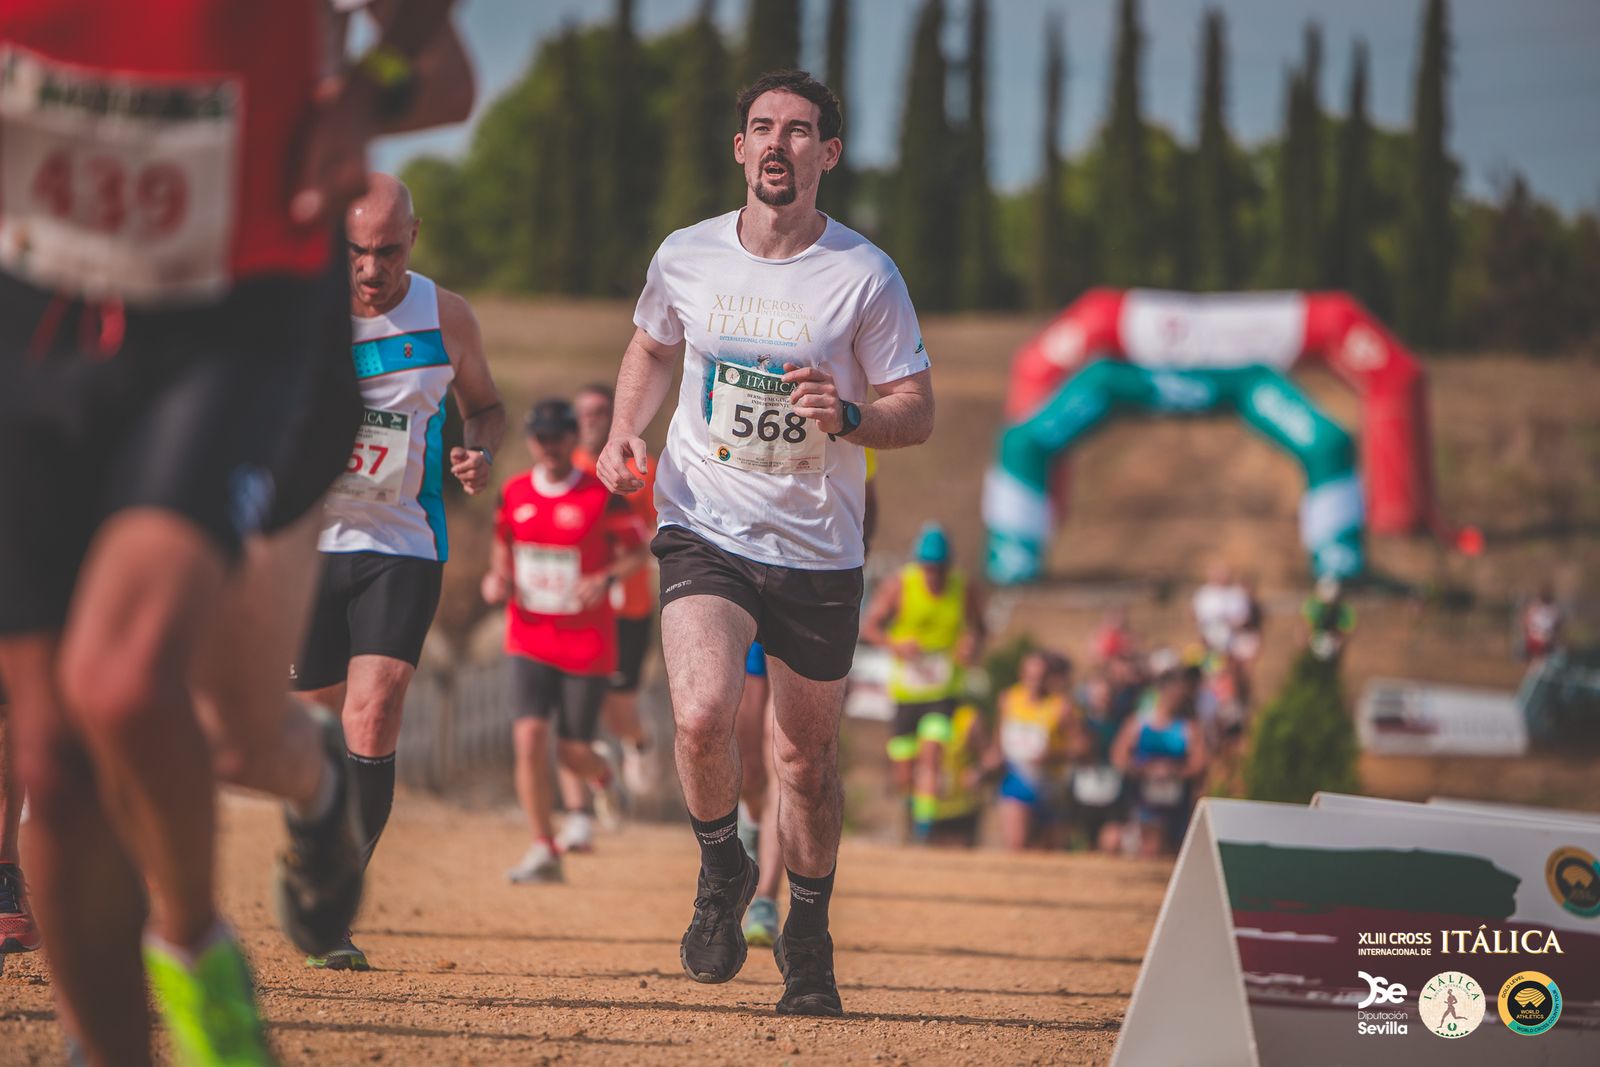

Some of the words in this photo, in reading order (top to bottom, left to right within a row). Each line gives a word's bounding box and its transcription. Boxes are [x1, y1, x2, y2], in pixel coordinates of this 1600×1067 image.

[33, 151, 188, 240] 439
[712, 294, 762, 313] XLIII
[762, 298, 804, 313] CROSS
[732, 404, 807, 444] 568
[346, 442, 389, 475] 57
